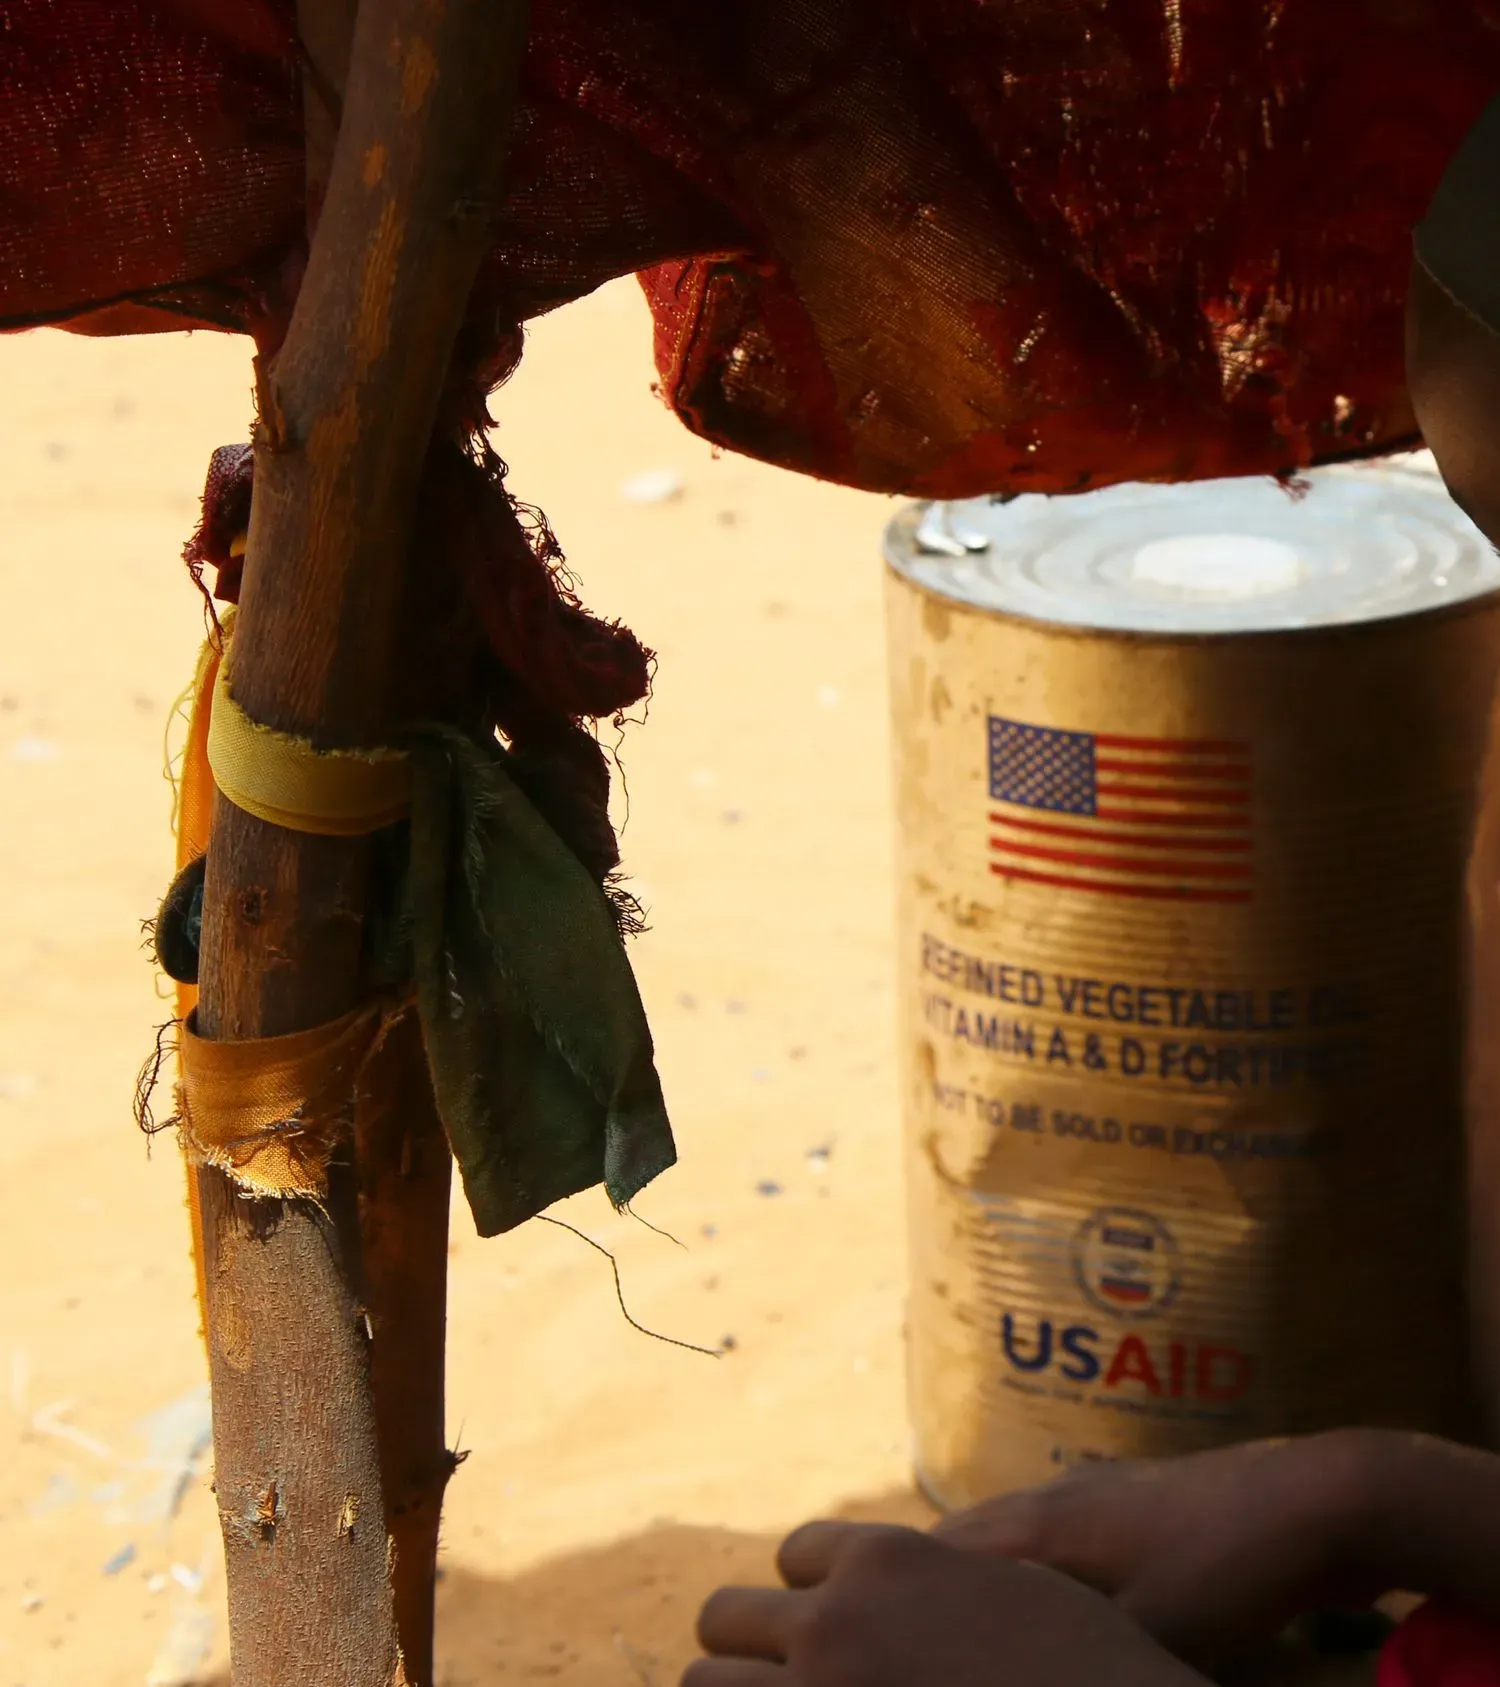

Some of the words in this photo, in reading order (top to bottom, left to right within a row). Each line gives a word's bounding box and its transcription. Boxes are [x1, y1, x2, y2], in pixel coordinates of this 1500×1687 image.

[922, 931, 1044, 1008] REFINED
[1053, 973, 1296, 1032] VEGETABLE
[924, 994, 1036, 1060] VITAMIN
[1046, 1024, 1073, 1067] A
[1081, 1034, 1106, 1071] &
[1120, 1036, 1146, 1076] D
[1009, 1100, 1044, 1135] BE
[1051, 1106, 1122, 1145] SOLD
[1127, 1121, 1169, 1152] OR
[1002, 1312, 1252, 1400] USAID
